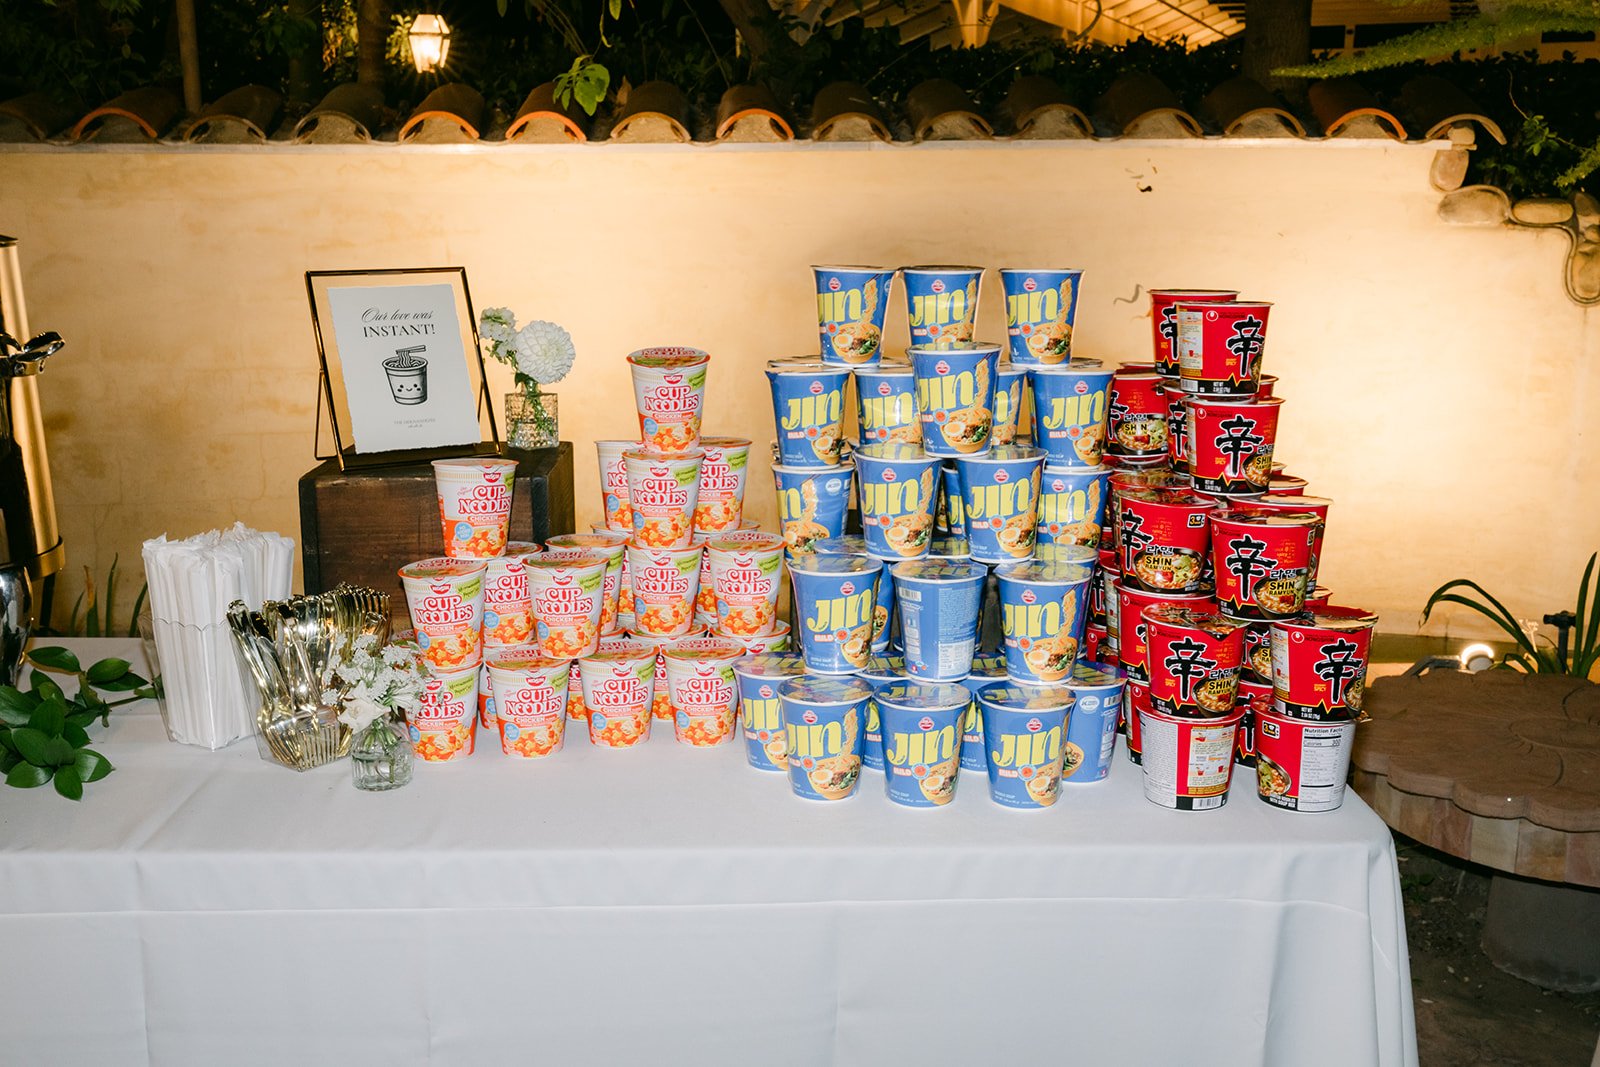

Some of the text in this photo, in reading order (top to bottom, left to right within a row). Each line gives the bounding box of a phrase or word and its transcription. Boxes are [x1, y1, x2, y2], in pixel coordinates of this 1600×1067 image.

[361, 307, 434, 323] Our love was
[363, 323, 436, 338] INSTANT!
[1225, 314, 1265, 378] 辛
[655, 385, 691, 400] CUP
[644, 395, 699, 413] NOODLES
[781, 389, 840, 430] JIN
[1043, 390, 1104, 429] JIN
[1214, 413, 1264, 477] 辛
[473, 485, 507, 500] CUP
[642, 478, 679, 493] CUP
[633, 489, 688, 507] NOODLES
[966, 478, 1030, 520] JIN
[1146, 545, 1174, 556] 라면
[1145, 556, 1172, 566] SHIN
[1225, 533, 1278, 601] 辛
[644, 567, 680, 582] CUP
[726, 568, 762, 583] CUP
[635, 576, 689, 594] NOODLES
[717, 576, 771, 595] NOODLES
[1269, 580, 1296, 590] SHIN
[424, 595, 463, 611] CUP
[544, 588, 583, 601] CUP
[414, 604, 474, 624] NOODLES
[536, 597, 593, 615] NOODLES
[806, 588, 872, 632] JIN
[1164, 636, 1218, 702] 辛
[1313, 637, 1363, 705] 辛
[604, 678, 641, 692] CUP
[687, 678, 724, 692] CUP
[1208, 680, 1232, 690] SHIN
[516, 686, 555, 703] CUP
[592, 687, 648, 706] NOODLES
[676, 687, 733, 706] NOODLES
[505, 696, 562, 716] NOODLES
[886, 725, 955, 766] JIN
[992, 726, 1061, 768] JIN
